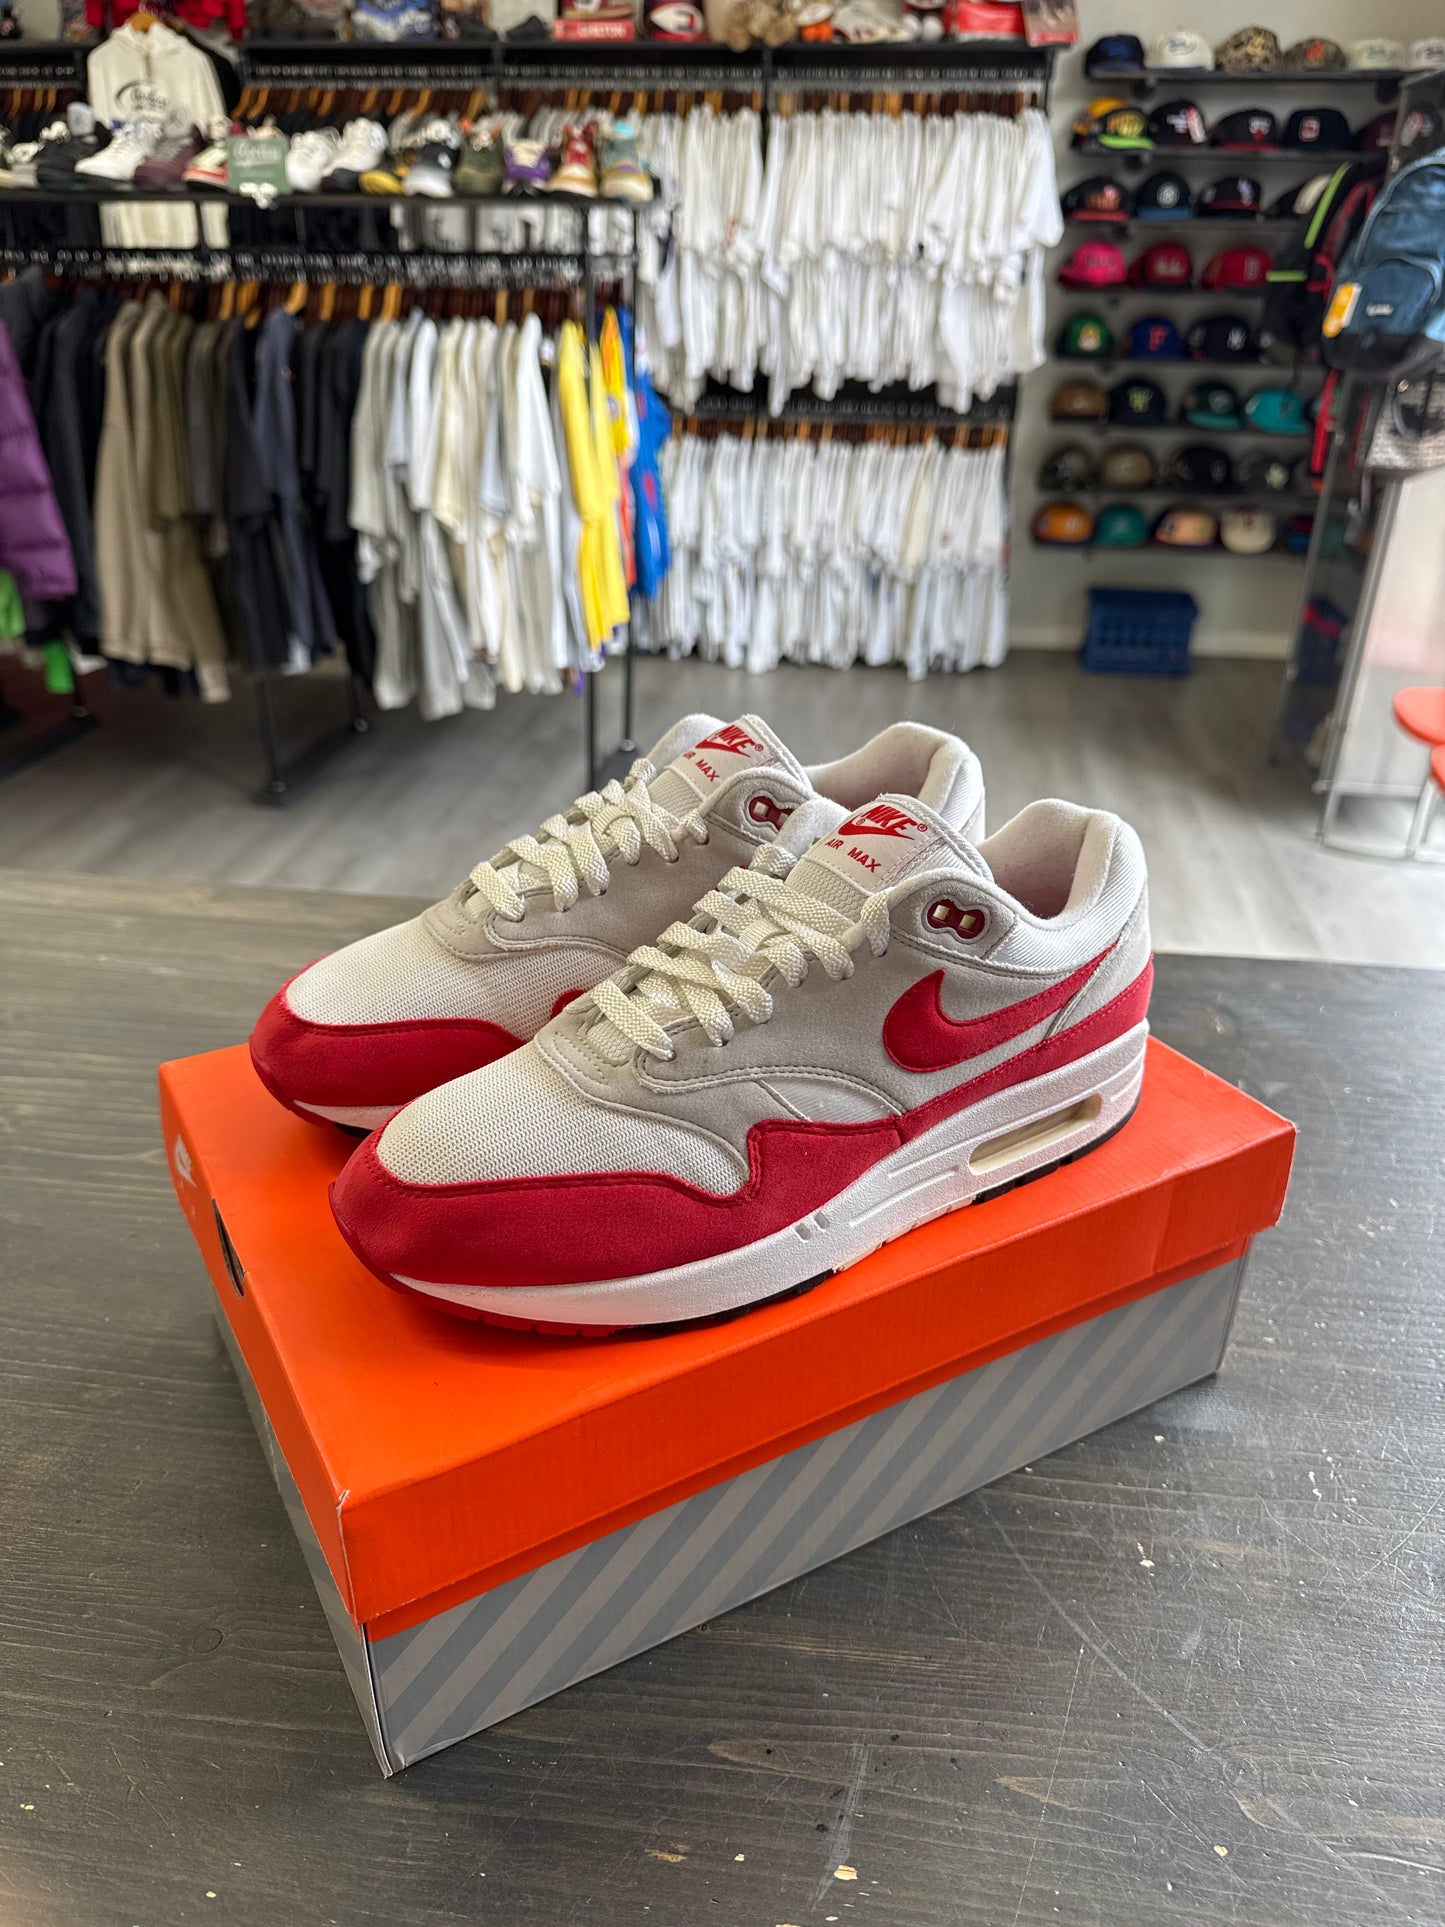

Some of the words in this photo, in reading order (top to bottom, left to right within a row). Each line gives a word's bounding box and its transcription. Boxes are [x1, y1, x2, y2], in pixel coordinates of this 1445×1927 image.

[717, 724, 757, 748] NIKE
[695, 758, 720, 783] MAX
[863, 804, 918, 831] NIKE
[825, 838, 844, 850] AIR
[847, 847, 882, 873] MAX
